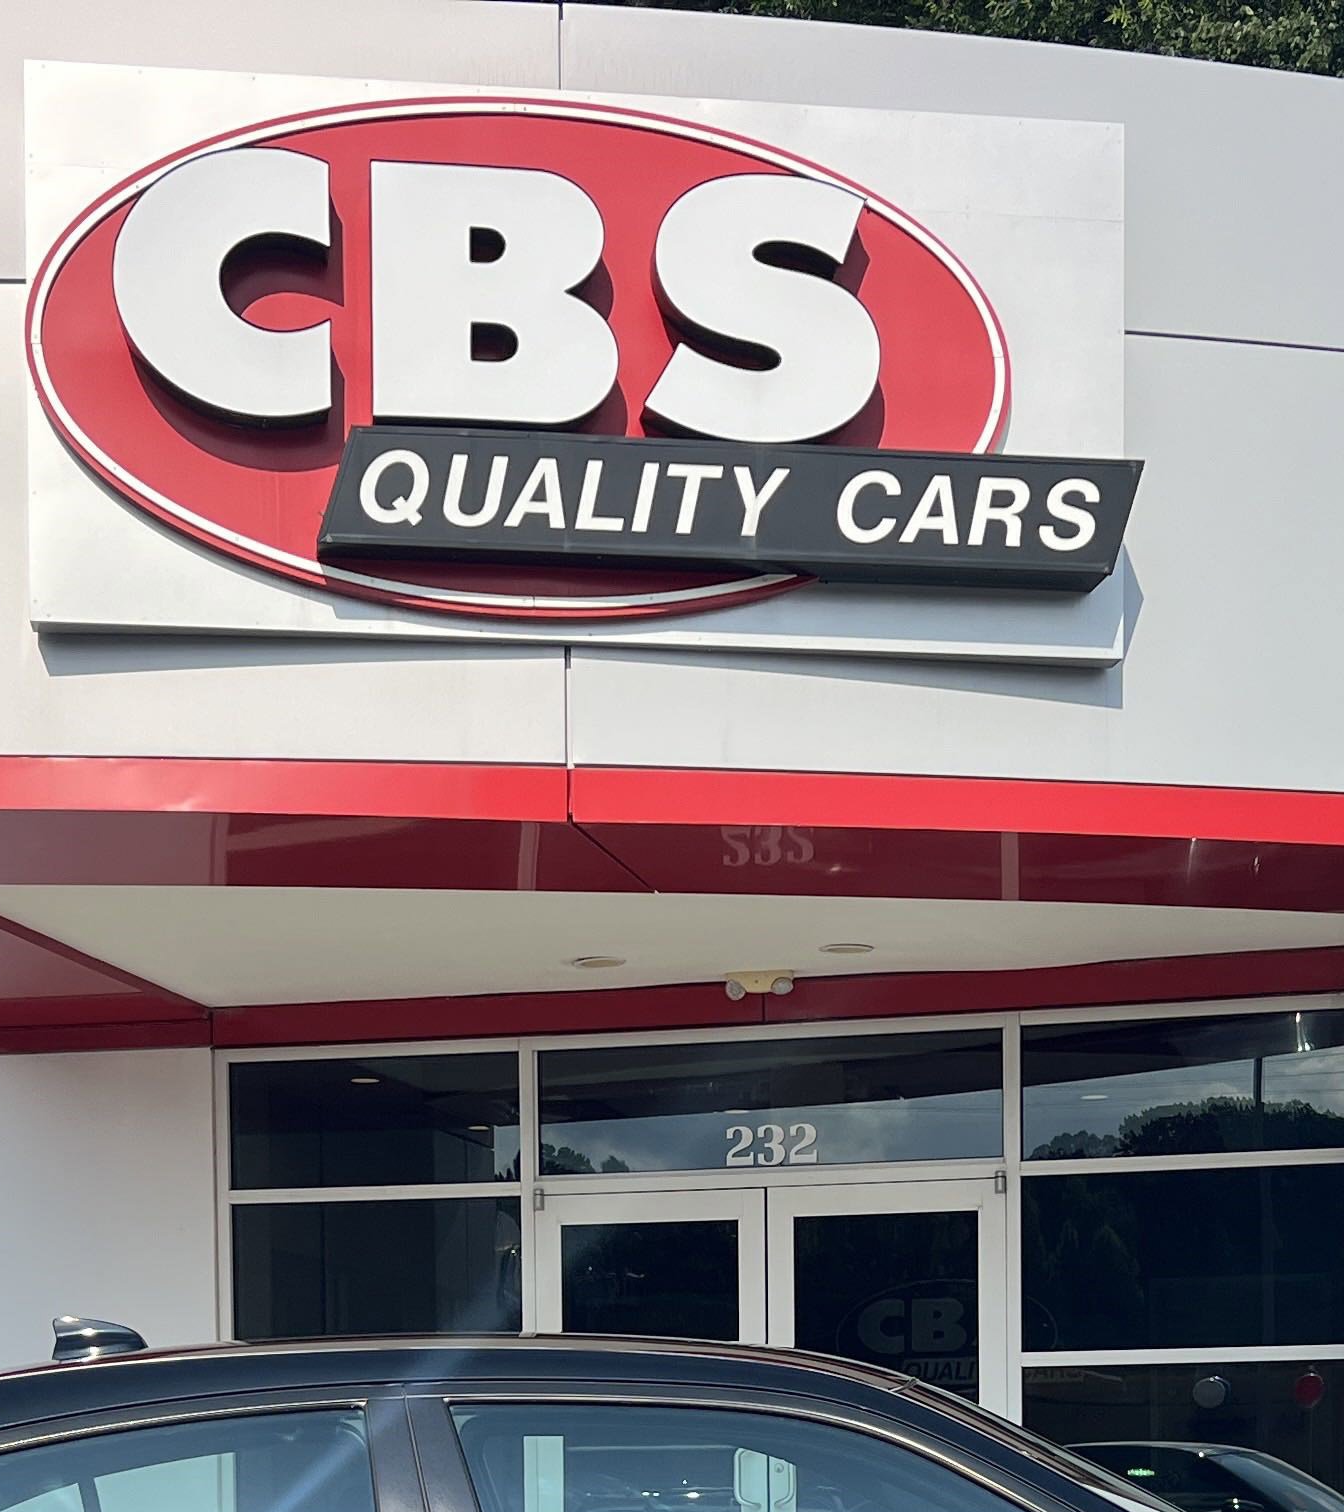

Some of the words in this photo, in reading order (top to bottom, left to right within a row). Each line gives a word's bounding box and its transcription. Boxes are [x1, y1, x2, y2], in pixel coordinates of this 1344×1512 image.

[113, 147, 882, 444] CBS
[359, 449, 790, 538] QUALITY
[836, 469, 1100, 552] CARS
[725, 1123, 817, 1167] 232
[858, 1298, 978, 1355] CB
